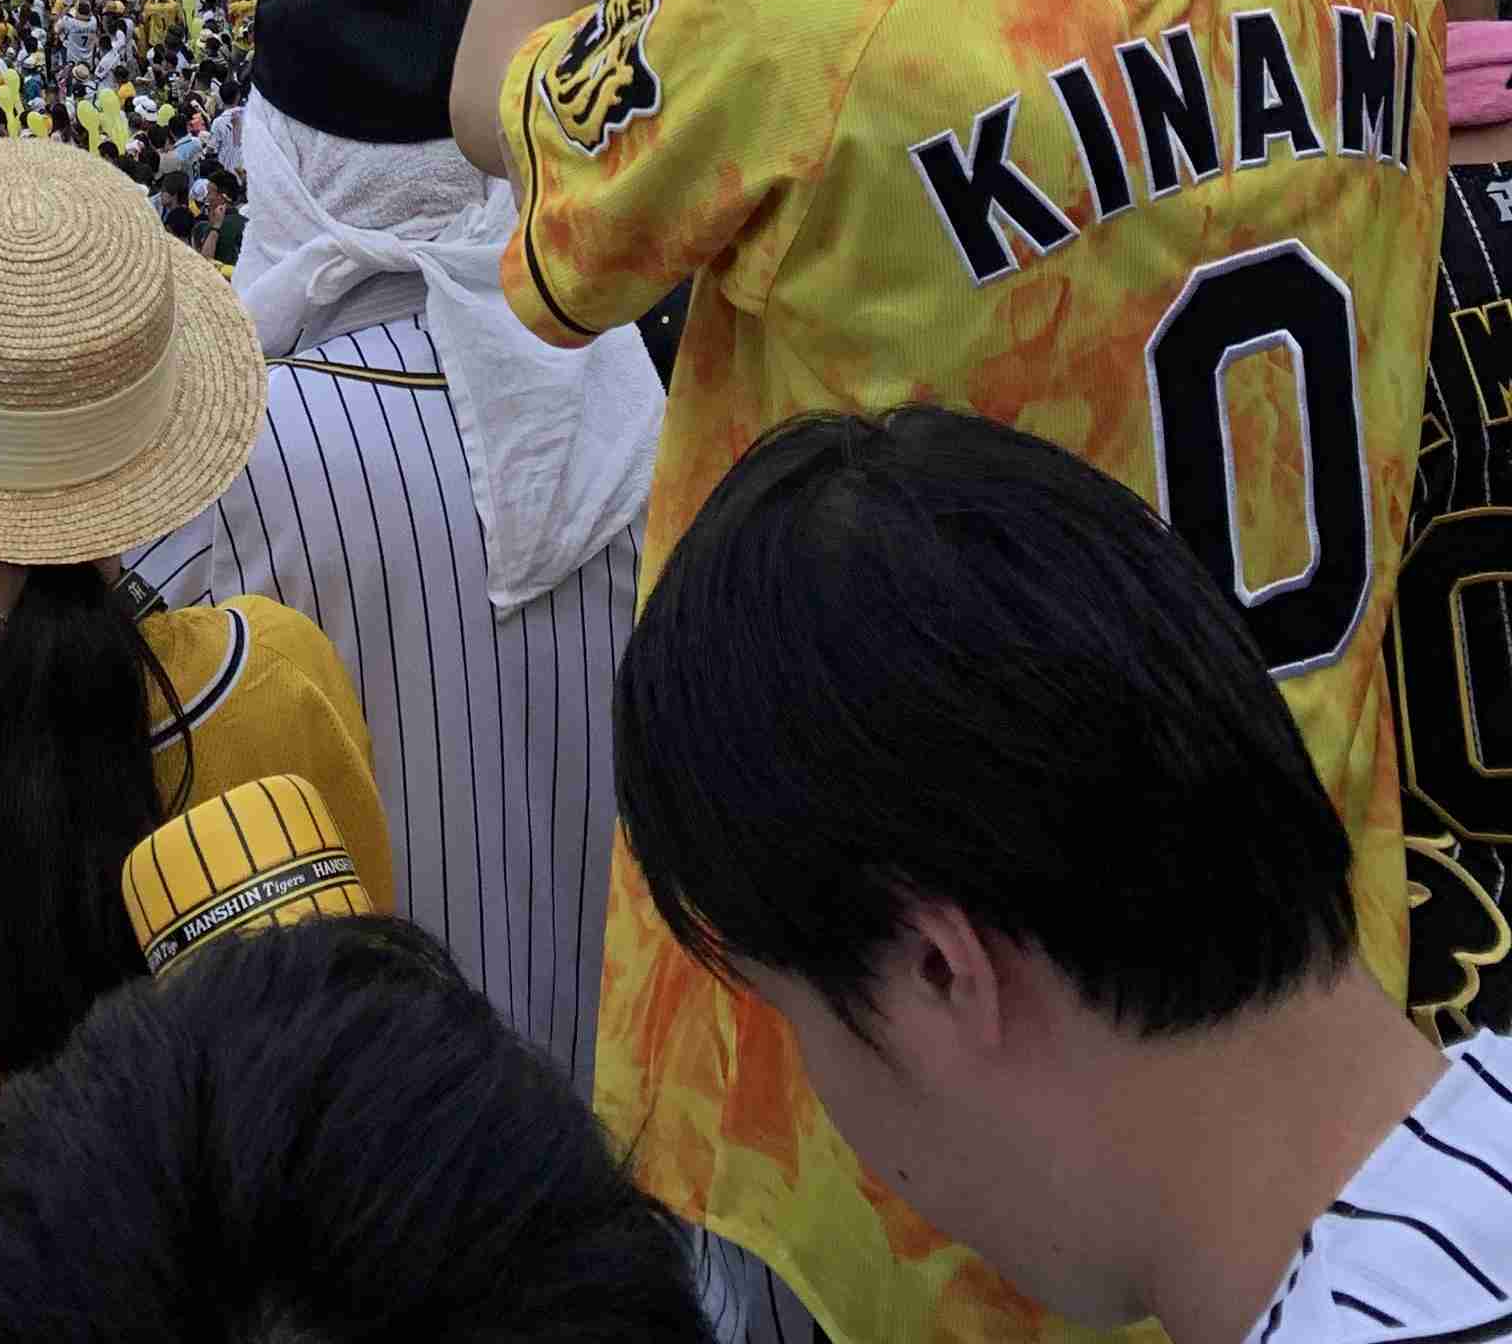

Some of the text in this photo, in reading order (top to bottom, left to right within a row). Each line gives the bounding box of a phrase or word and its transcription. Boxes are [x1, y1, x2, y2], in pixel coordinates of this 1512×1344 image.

[908, 4, 1417, 289] KINAMI
[1144, 238, 1372, 679] 0
[183, 886, 265, 943] HANSHIN
[262, 872, 307, 898] Tigers
